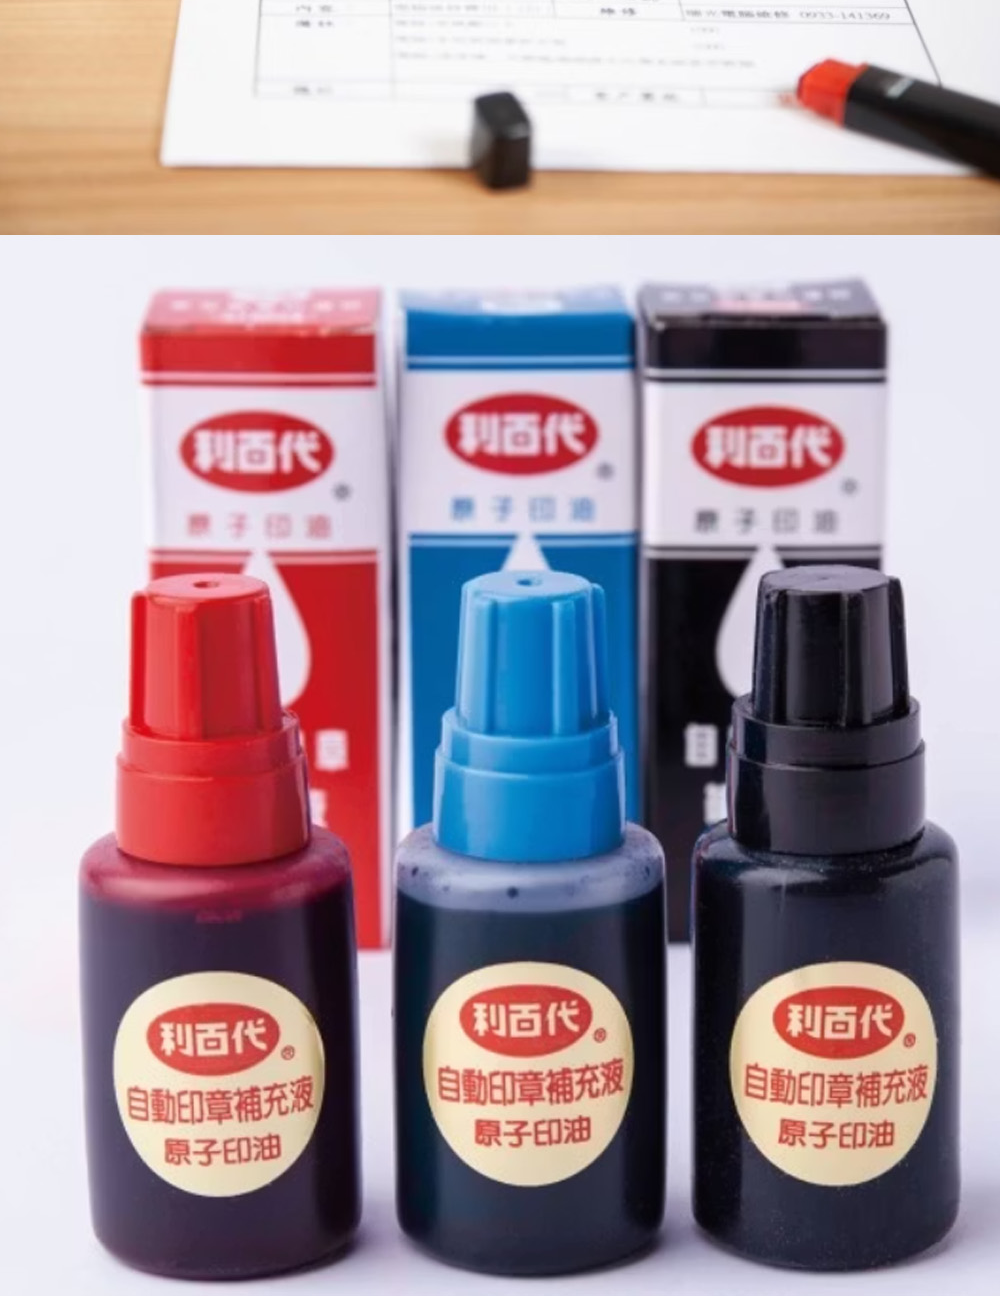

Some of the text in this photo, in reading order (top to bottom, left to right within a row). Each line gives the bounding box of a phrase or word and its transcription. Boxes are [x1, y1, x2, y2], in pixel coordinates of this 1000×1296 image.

[193, 429, 322, 474] 利百代
[458, 412, 587, 457] 利百代
[704, 424, 832, 470] 利百代
[188, 512, 332, 540] 原子印油
[451, 496, 596, 522] 原子印油
[694, 508, 838, 534] 原子印油
[159, 1017, 268, 1057] 利百代
[473, 999, 580, 1038] 利百代
[786, 1003, 893, 1040] 利百代
[126, 1075, 315, 1126] 自動印章補充液
[437, 1058, 625, 1107] 自動印章補充液
[744, 1062, 929, 1109] 自動印章補充液
[164, 1132, 282, 1167] 原子印油
[474, 1115, 592, 1148] 原子印油
[777, 1118, 895, 1150] 原子印油
